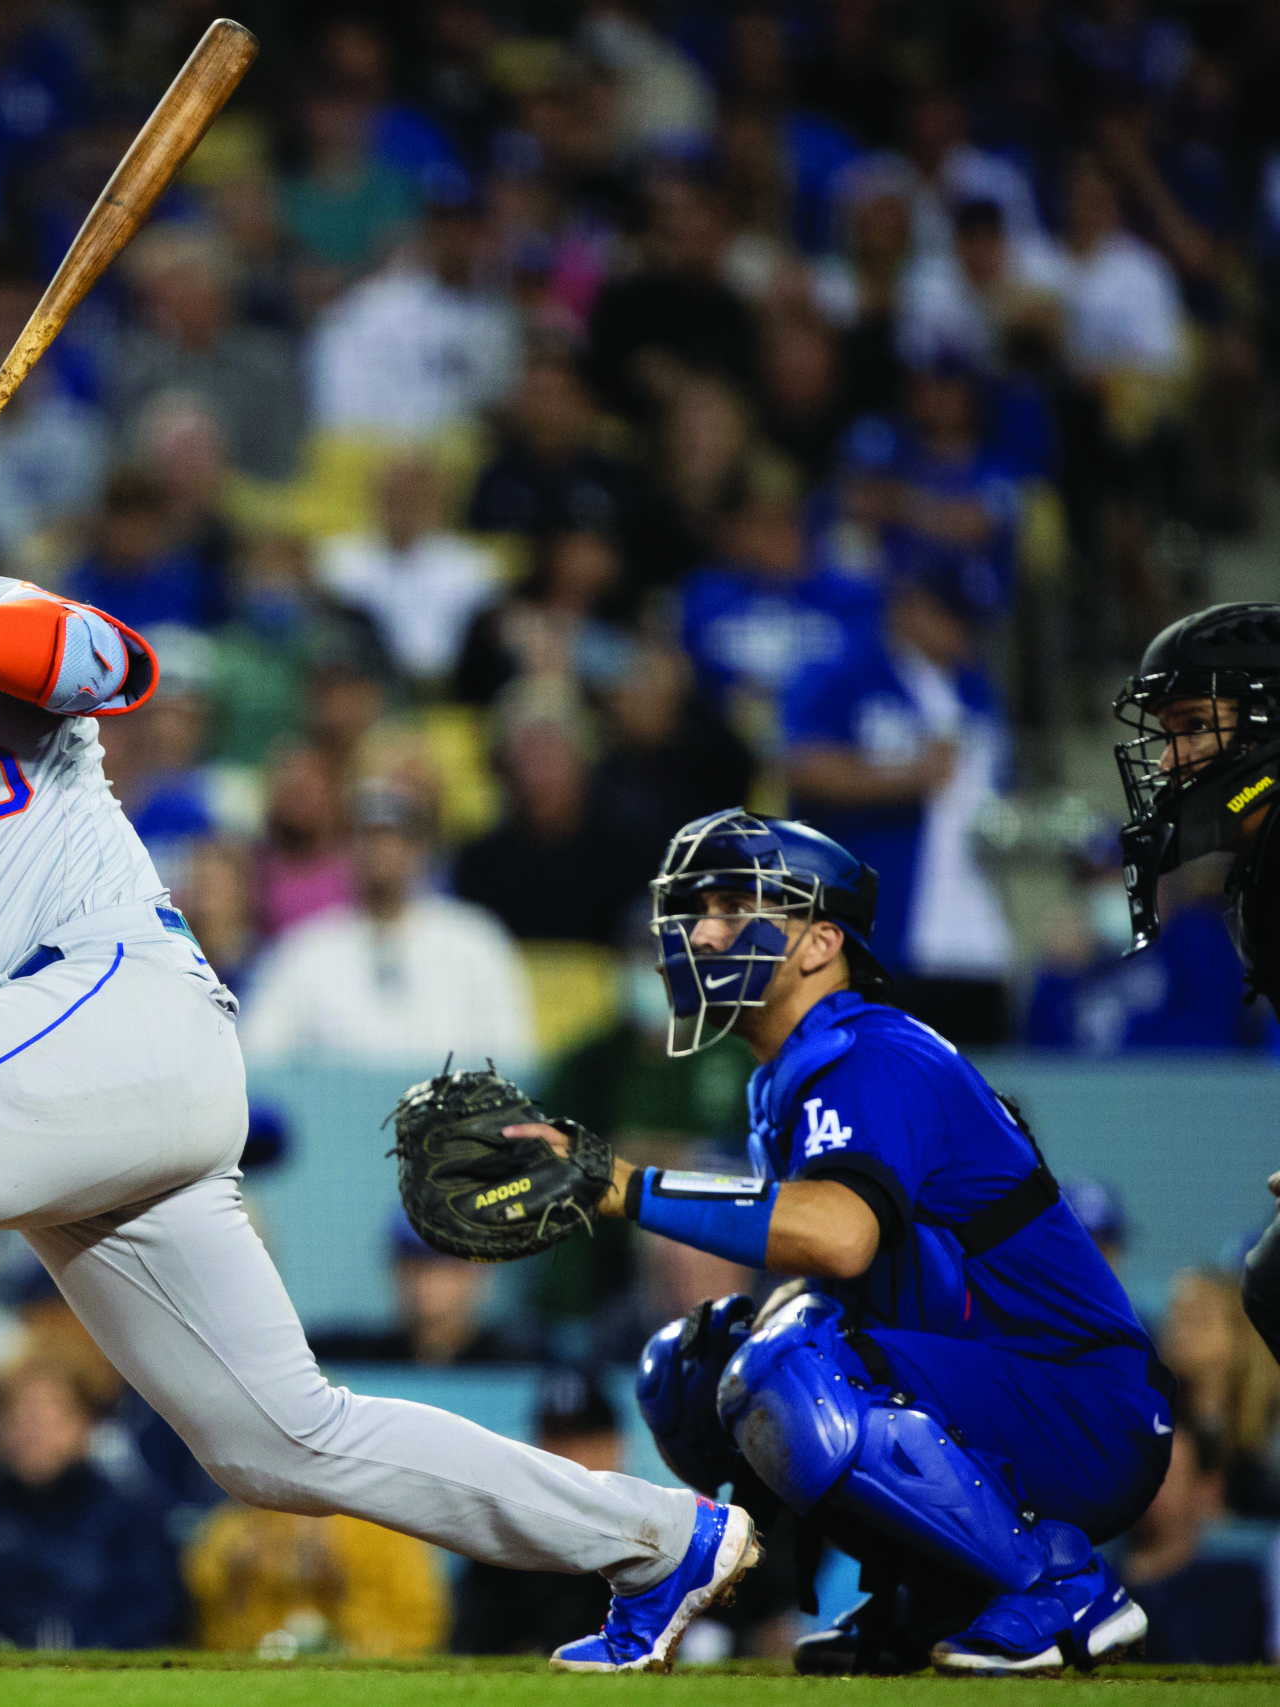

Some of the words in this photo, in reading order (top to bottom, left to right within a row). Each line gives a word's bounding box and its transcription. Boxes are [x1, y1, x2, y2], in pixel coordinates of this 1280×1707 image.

[1227, 776, 1274, 813] Wilson
[803, 1097, 853, 1159] LA
[475, 1177, 532, 1210] A2000
